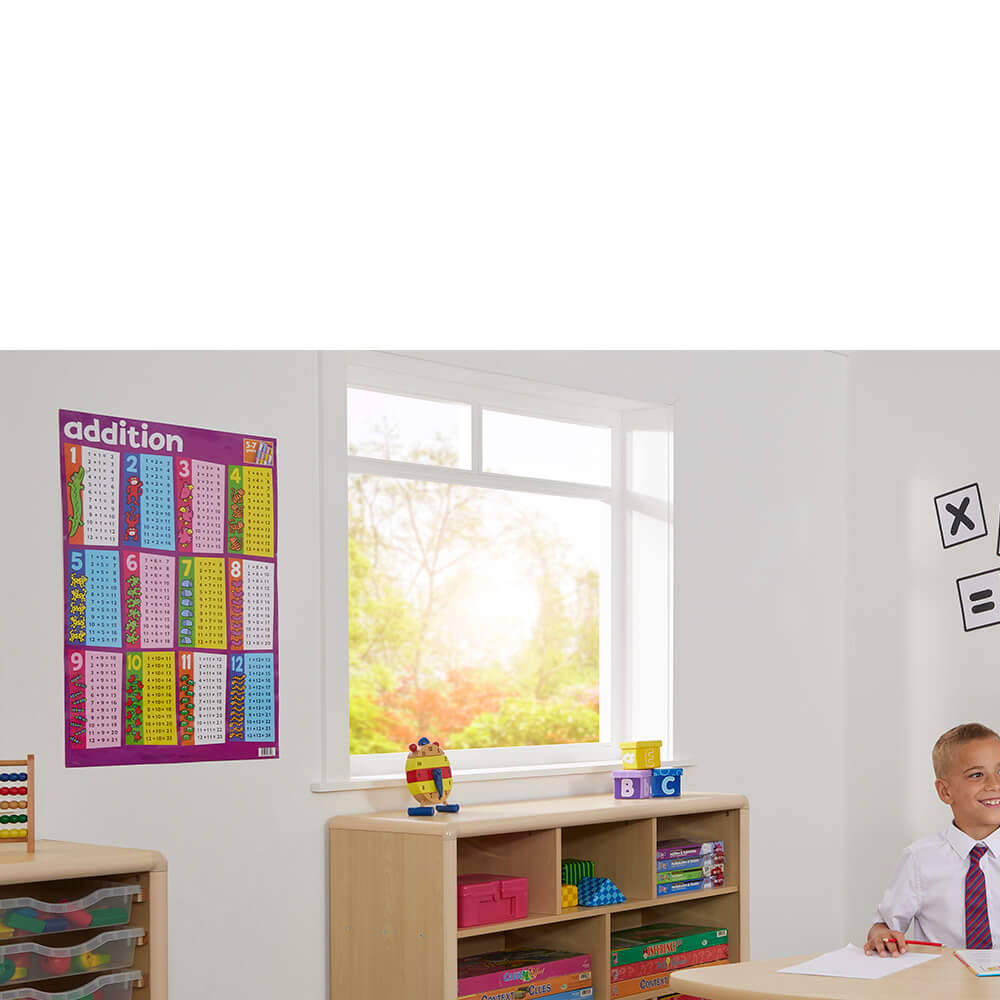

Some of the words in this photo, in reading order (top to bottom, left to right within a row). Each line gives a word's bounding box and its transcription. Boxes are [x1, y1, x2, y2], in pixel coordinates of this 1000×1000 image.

[64, 418, 183, 452] addition
[70, 447, 76, 463] 1
[126, 456, 138, 472] 2
[179, 460, 190, 477] 3
[230, 468, 241, 484] 4
[71, 552, 83, 571] 5
[127, 554, 137, 571] 6
[182, 560, 192, 576] 7
[231, 561, 240, 577] 8
[71, 652, 83, 671] 9
[128, 654, 141, 670] 10
[182, 654, 191, 670] 11
[232, 656, 243, 672] 12
[645, 748, 655, 768] E
[621, 778, 634, 797] B
[662, 776, 675, 795] C
[528, 983, 552, 996] CLUES
[640, 976, 668, 990] CONTEXT
